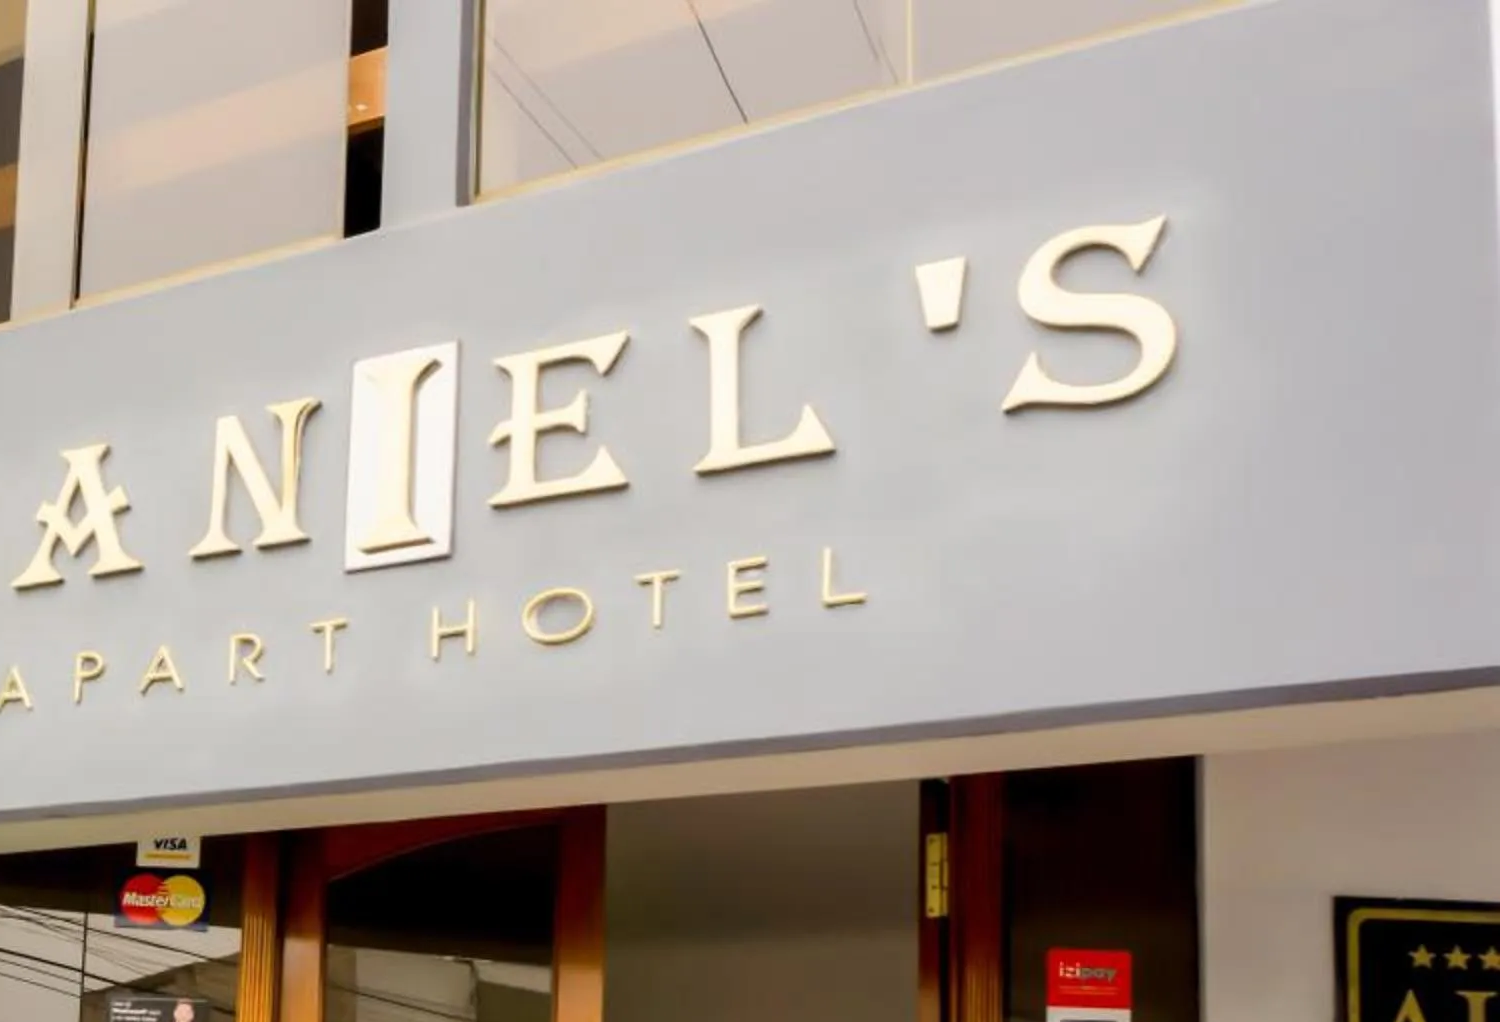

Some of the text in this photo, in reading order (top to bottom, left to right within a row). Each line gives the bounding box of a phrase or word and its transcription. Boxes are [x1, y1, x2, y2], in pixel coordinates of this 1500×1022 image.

[429, 547, 867, 661] HOTEL
[154, 837, 188, 850] VISA
[1059, 961, 1117, 984] izipay
